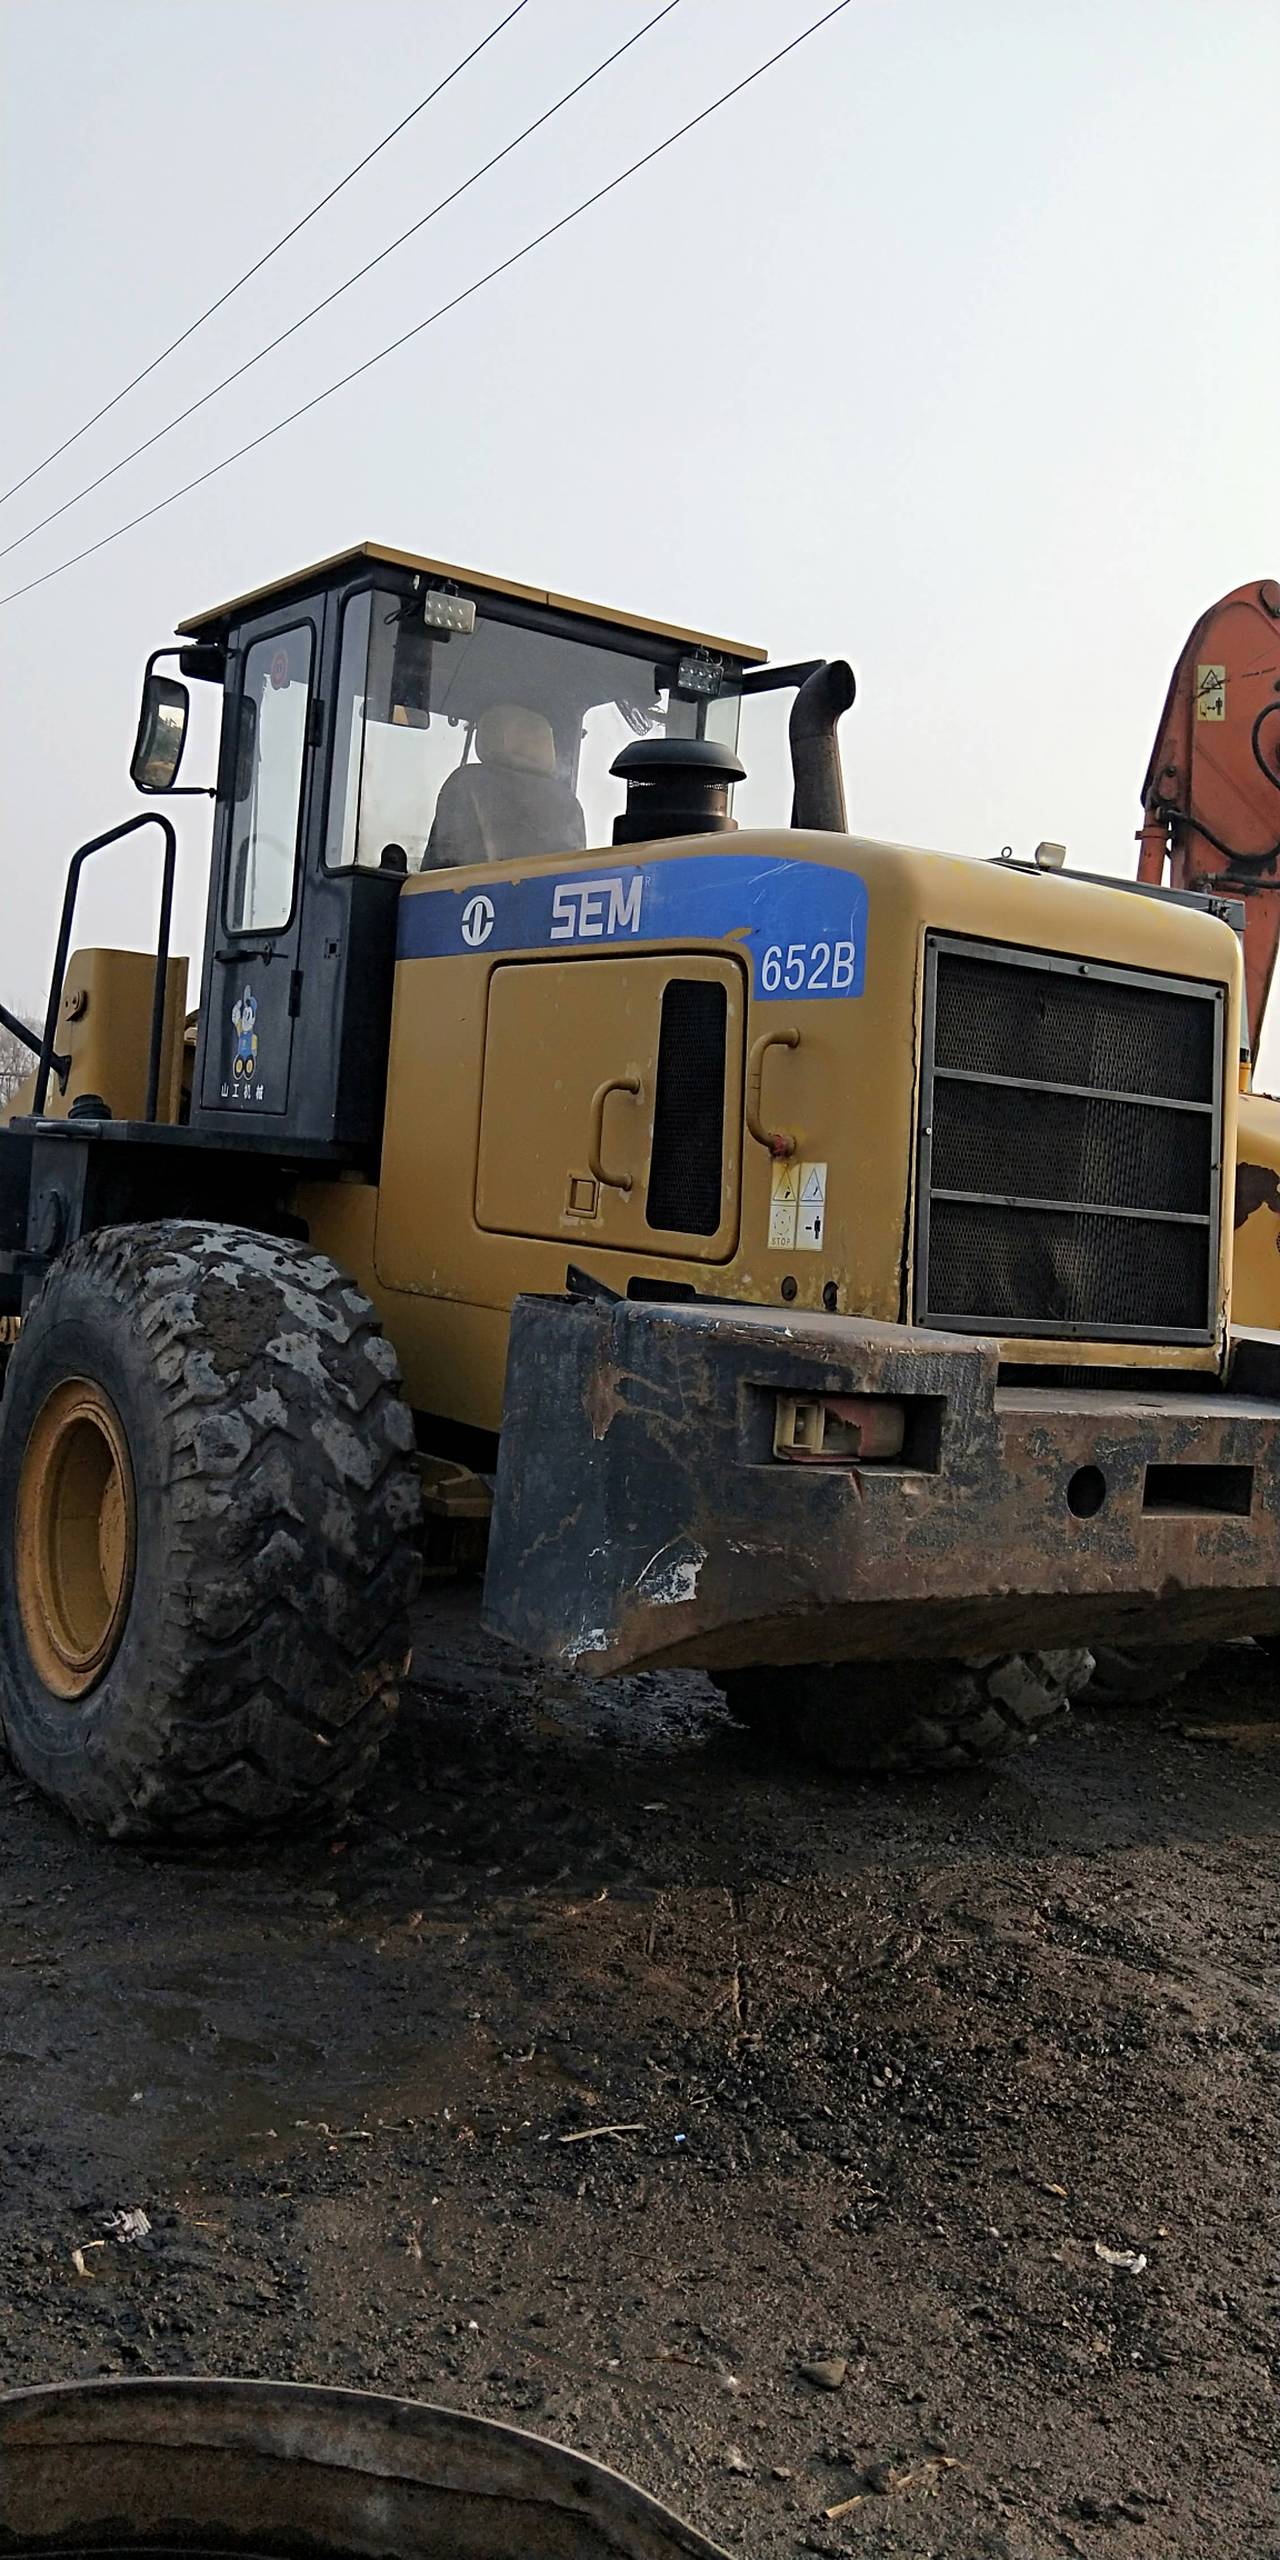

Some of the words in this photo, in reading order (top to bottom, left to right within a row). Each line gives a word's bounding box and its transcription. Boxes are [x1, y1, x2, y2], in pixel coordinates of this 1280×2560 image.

[550, 875, 644, 939] SEM
[761, 941, 855, 991] 652B
[221, 1083, 264, 1100] 山工机械
[772, 1237, 791, 1246] STOP
